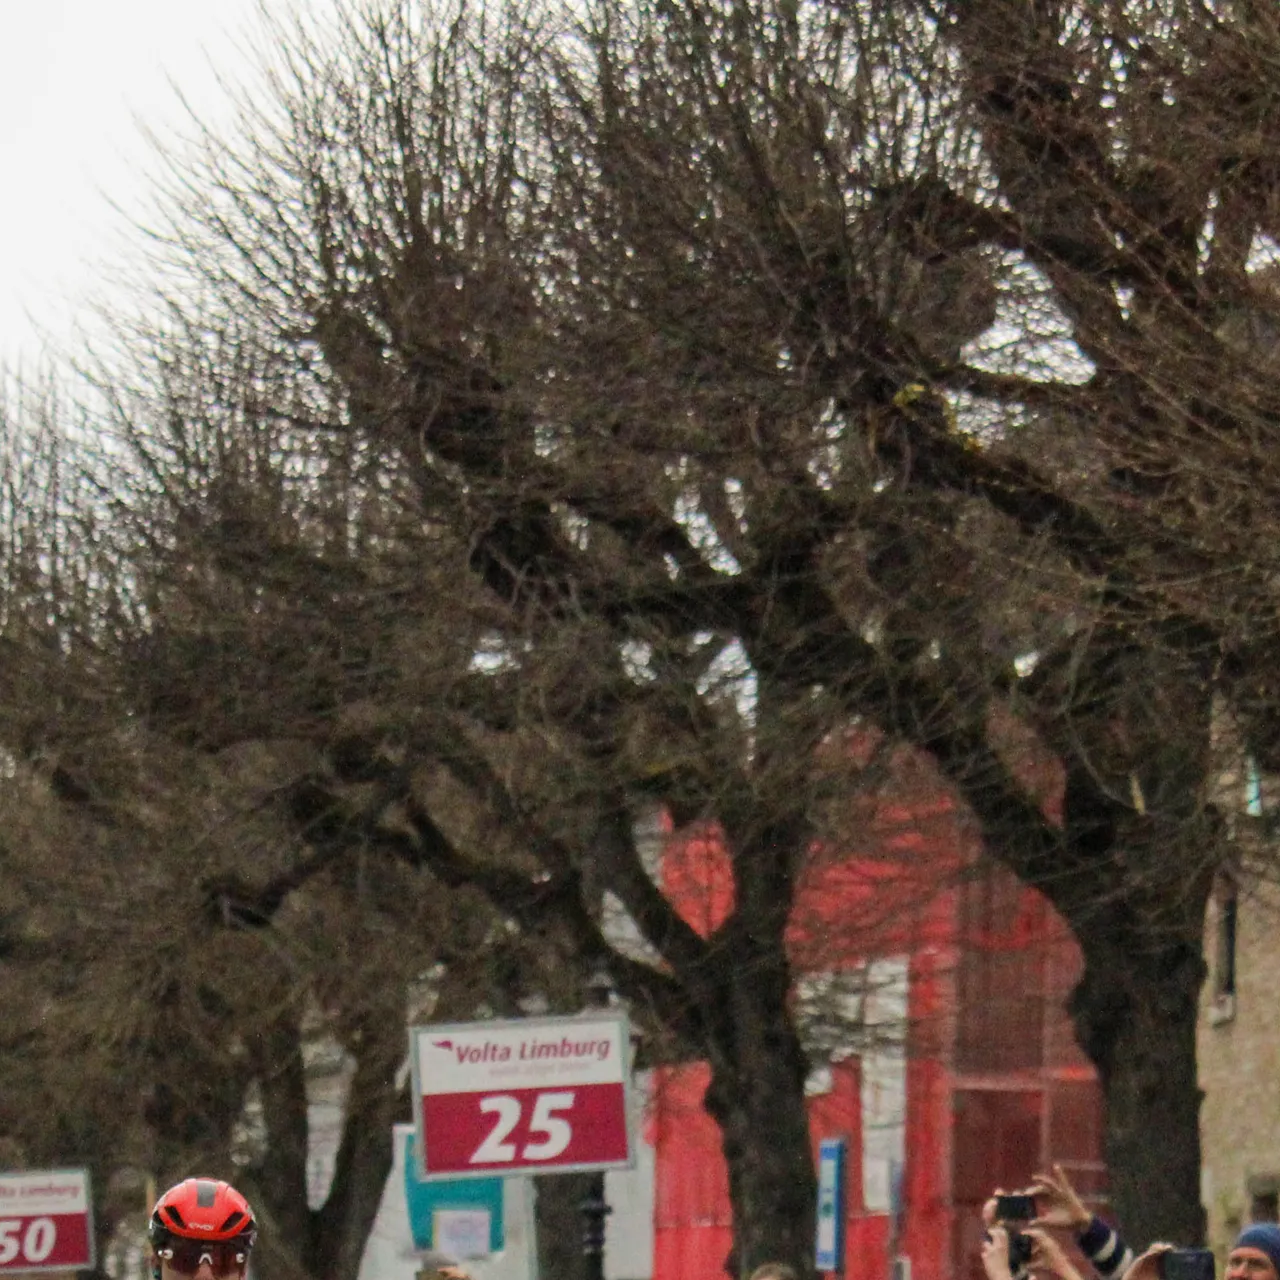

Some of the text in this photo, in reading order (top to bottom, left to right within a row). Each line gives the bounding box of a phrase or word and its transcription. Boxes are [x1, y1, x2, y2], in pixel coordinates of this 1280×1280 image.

[456, 1037, 611, 1063] Volta Limburg
[469, 1092, 576, 1164] 25
